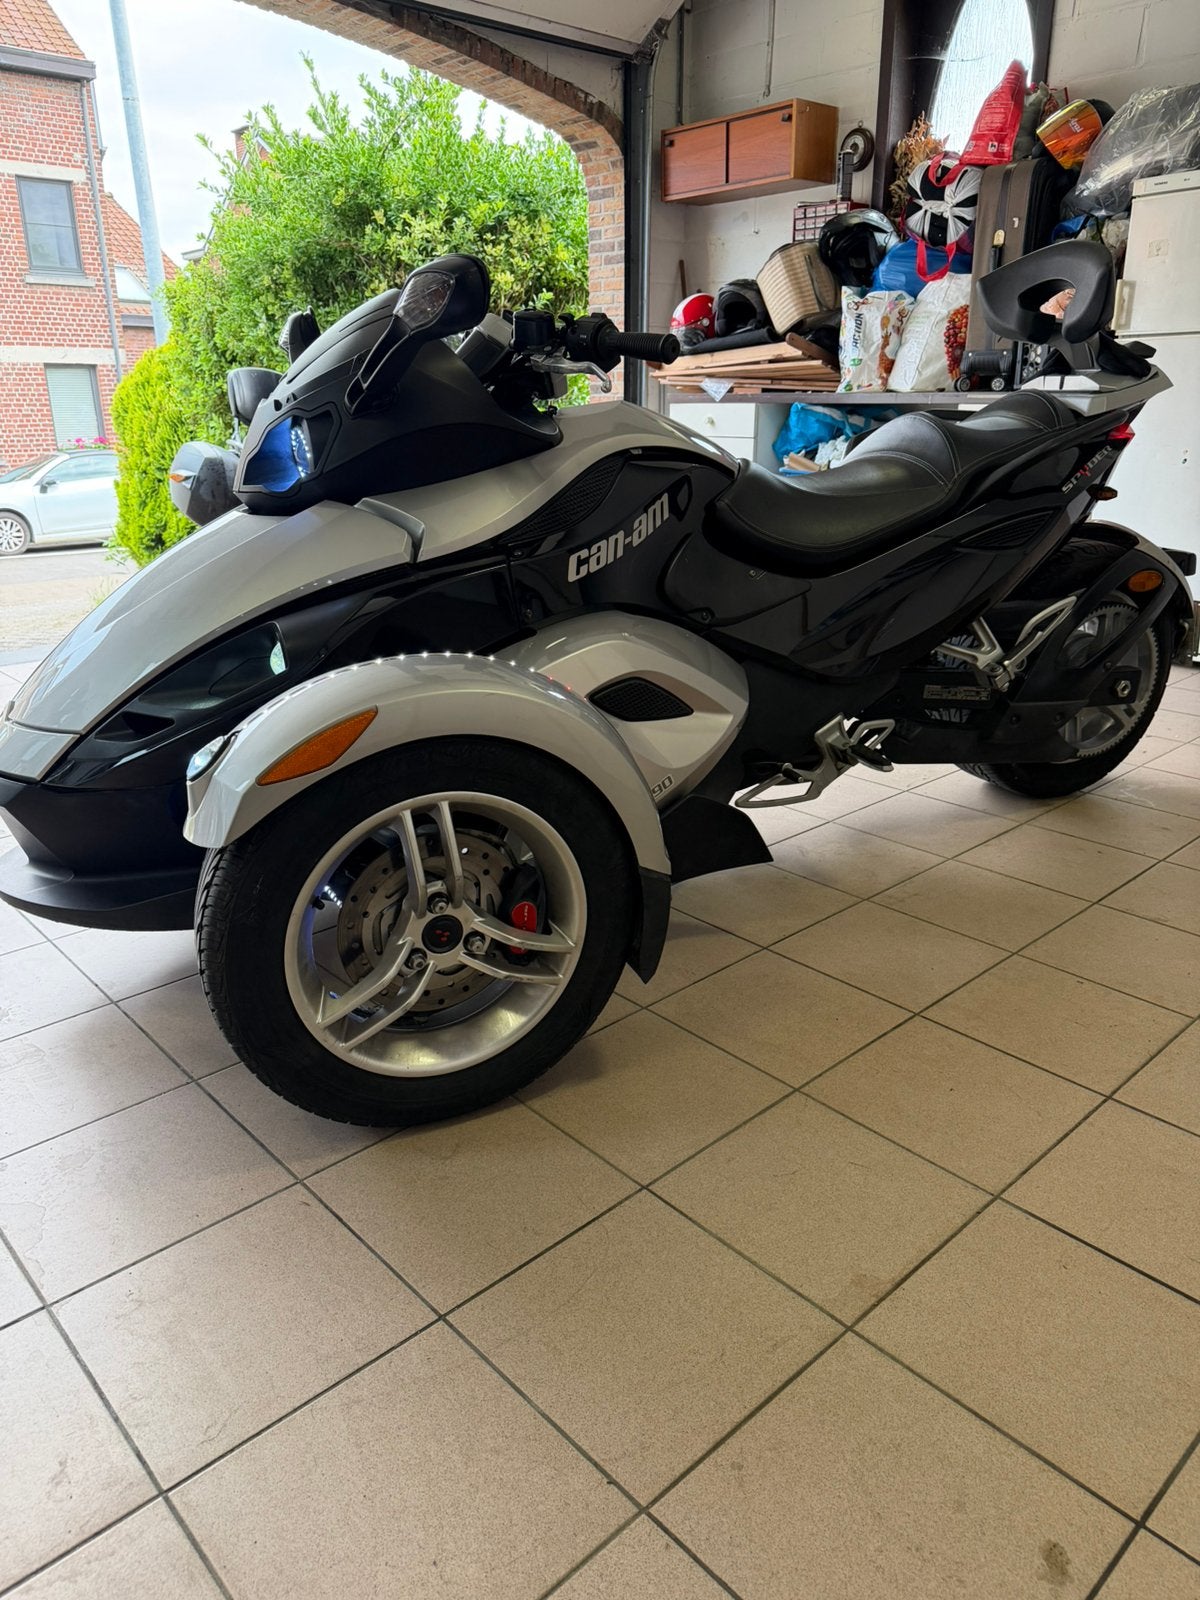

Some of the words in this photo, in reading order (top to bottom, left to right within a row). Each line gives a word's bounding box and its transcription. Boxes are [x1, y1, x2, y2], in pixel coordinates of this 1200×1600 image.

[851, 312, 864, 349] ACTION
[1062, 445, 1113, 494] SPYDER
[567, 492, 670, 583] can-am
